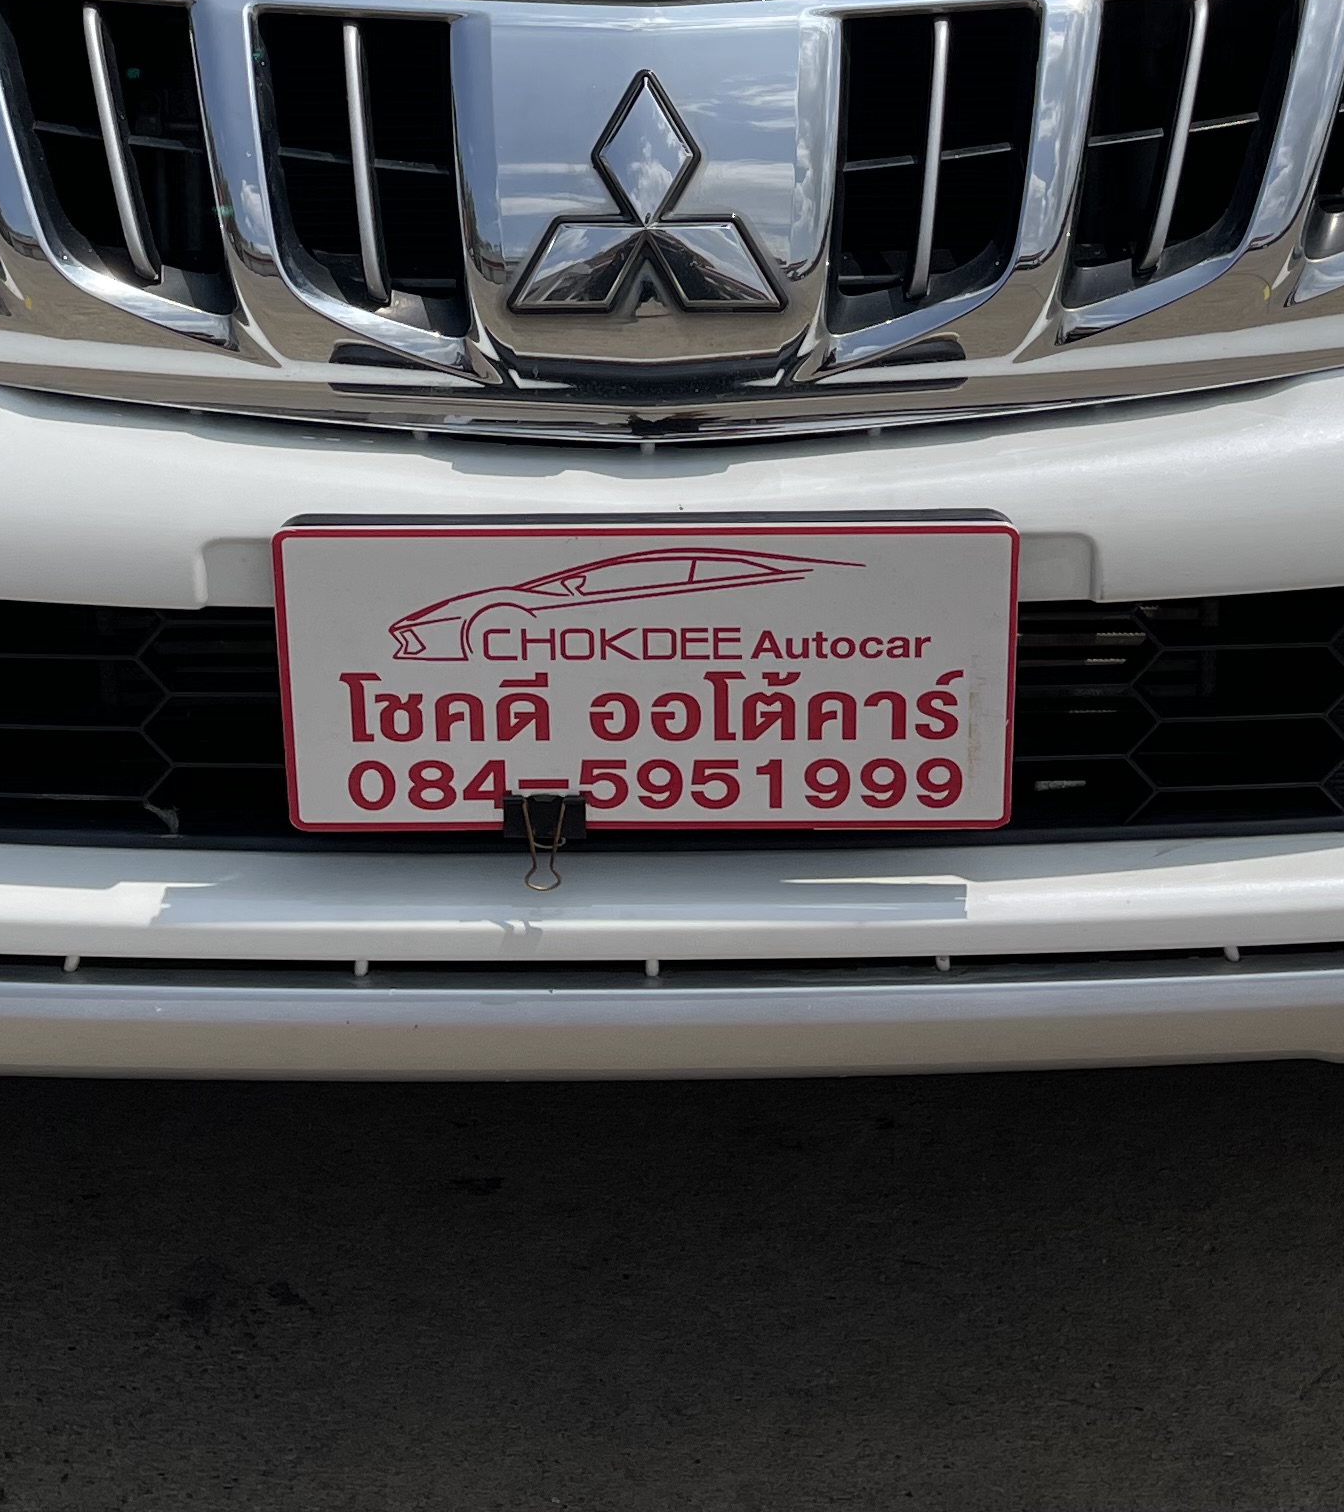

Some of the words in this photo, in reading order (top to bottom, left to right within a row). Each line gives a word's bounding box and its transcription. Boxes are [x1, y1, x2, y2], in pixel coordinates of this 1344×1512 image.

[482, 627, 742, 661] CHOKDEE
[751, 630, 931, 659] Autocar
[339, 672, 550, 743] โชคดี
[589, 669, 964, 742] ออโต้คาร์
[347, 757, 964, 811] 084-5951999
